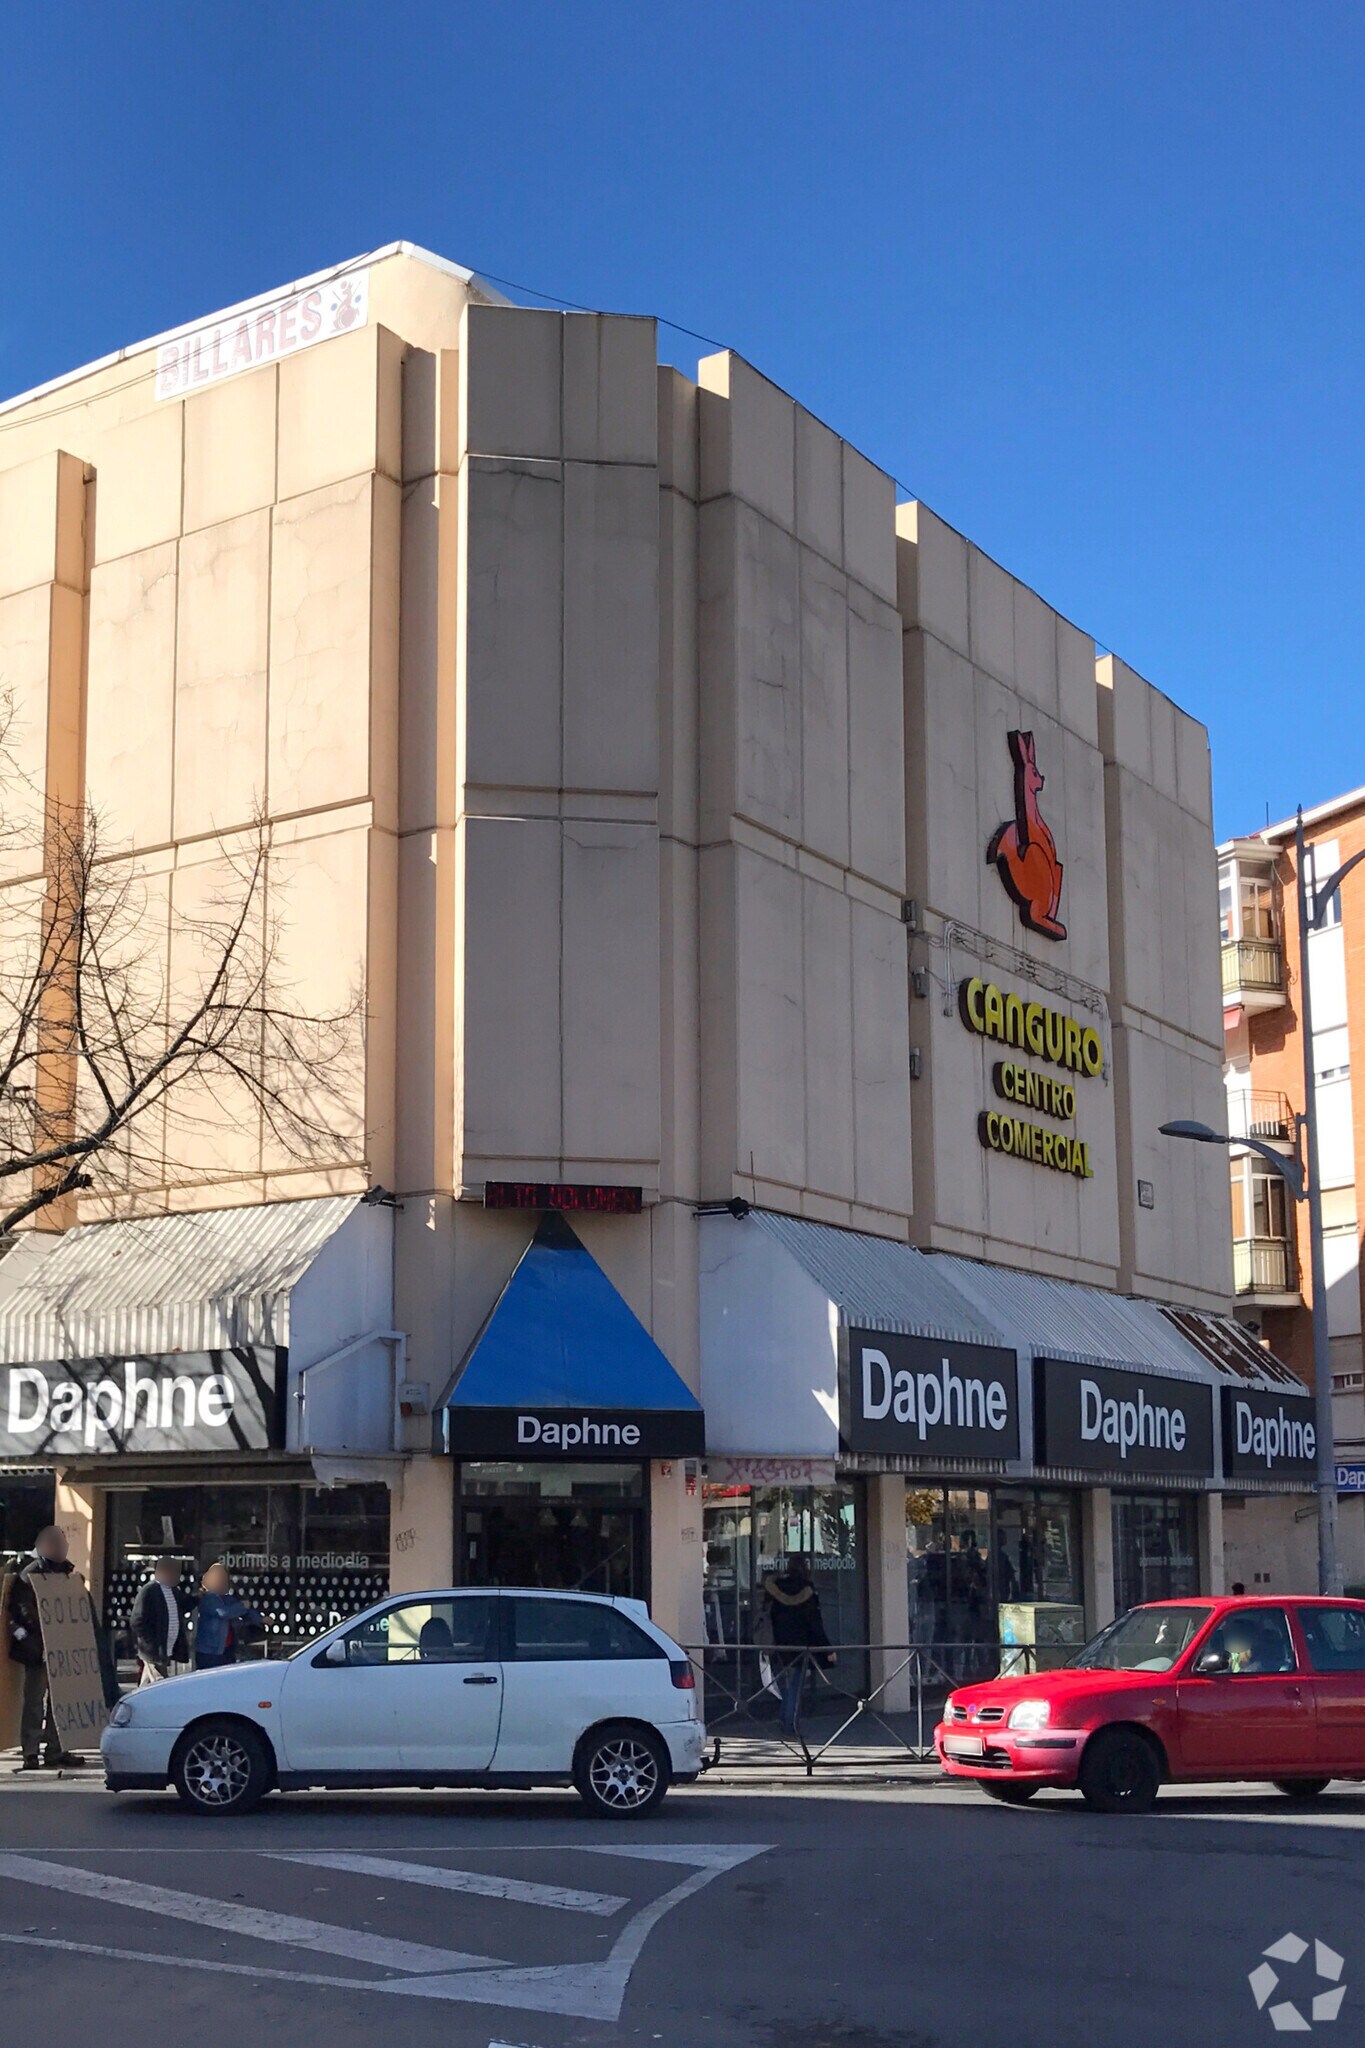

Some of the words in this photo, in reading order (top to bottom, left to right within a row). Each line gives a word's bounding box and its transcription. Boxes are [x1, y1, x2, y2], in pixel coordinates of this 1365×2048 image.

[160, 291, 323, 393] BILLARES
[963, 977, 1103, 1077] CANGURO
[998, 1061, 1076, 1119] CENTRO
[983, 1111, 1093, 1178] COMERCIAL
[8, 1361, 235, 1447] Daphne
[862, 1347, 1008, 1440] Daphne
[1080, 1379, 1186, 1458] Daphne
[517, 1416, 641, 1450] Daphne
[1236, 1401, 1316, 1468] Daphne
[218, 1551, 278, 1568] abrimos
[282, 1556, 291, 1568] a
[296, 1551, 370, 1569] mediodía
[41, 1597, 90, 1625] SOLO
[56, 1699, 109, 1731] SALVA
